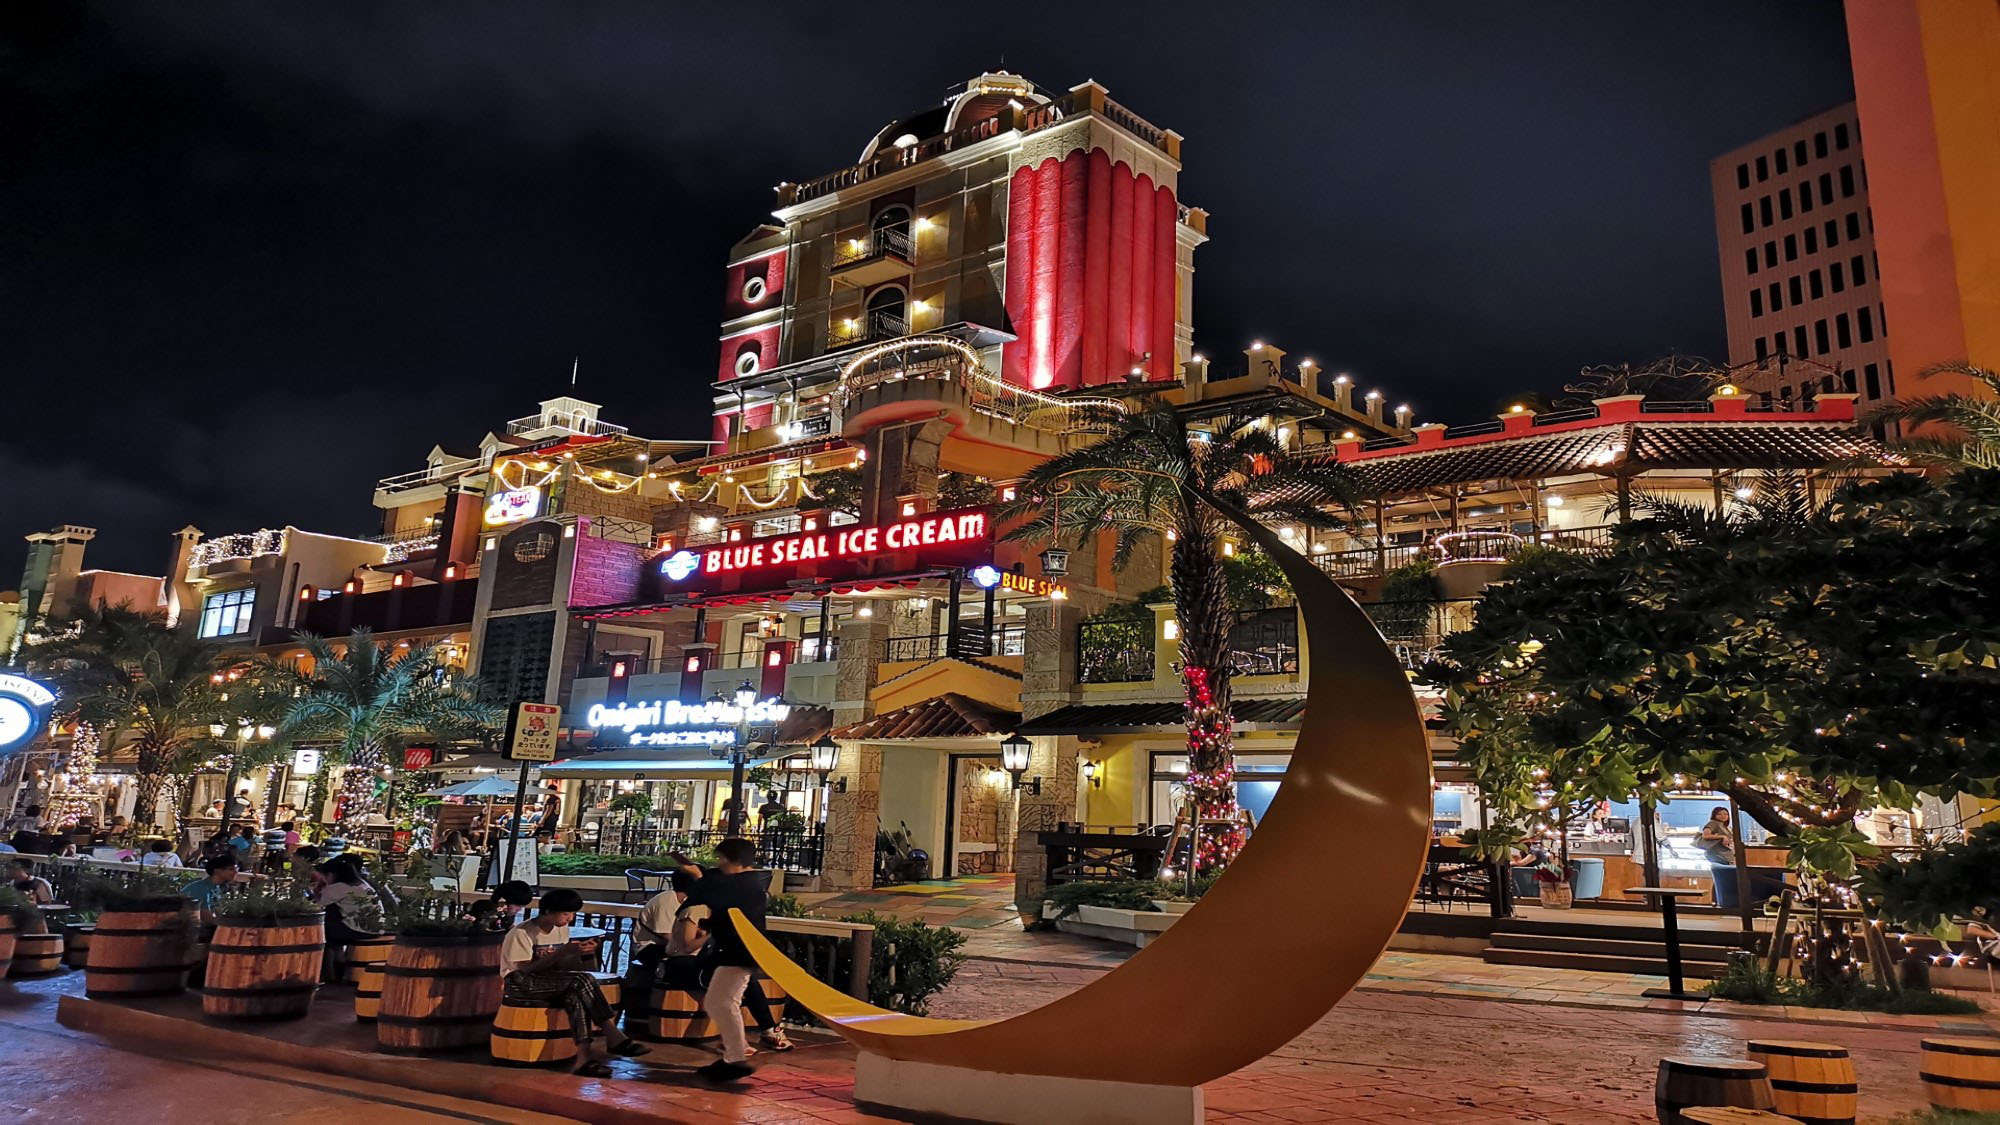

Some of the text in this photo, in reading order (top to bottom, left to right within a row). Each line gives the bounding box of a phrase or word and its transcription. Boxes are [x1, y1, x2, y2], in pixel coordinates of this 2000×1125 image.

[706, 543, 764, 573] BLUE
[770, 535, 829, 565] SEAL
[838, 527, 879, 555] ICE
[1002, 572, 1036, 593] BLUE
[587, 700, 662, 732] Onigiri
[407, 751, 431, 768] illy
